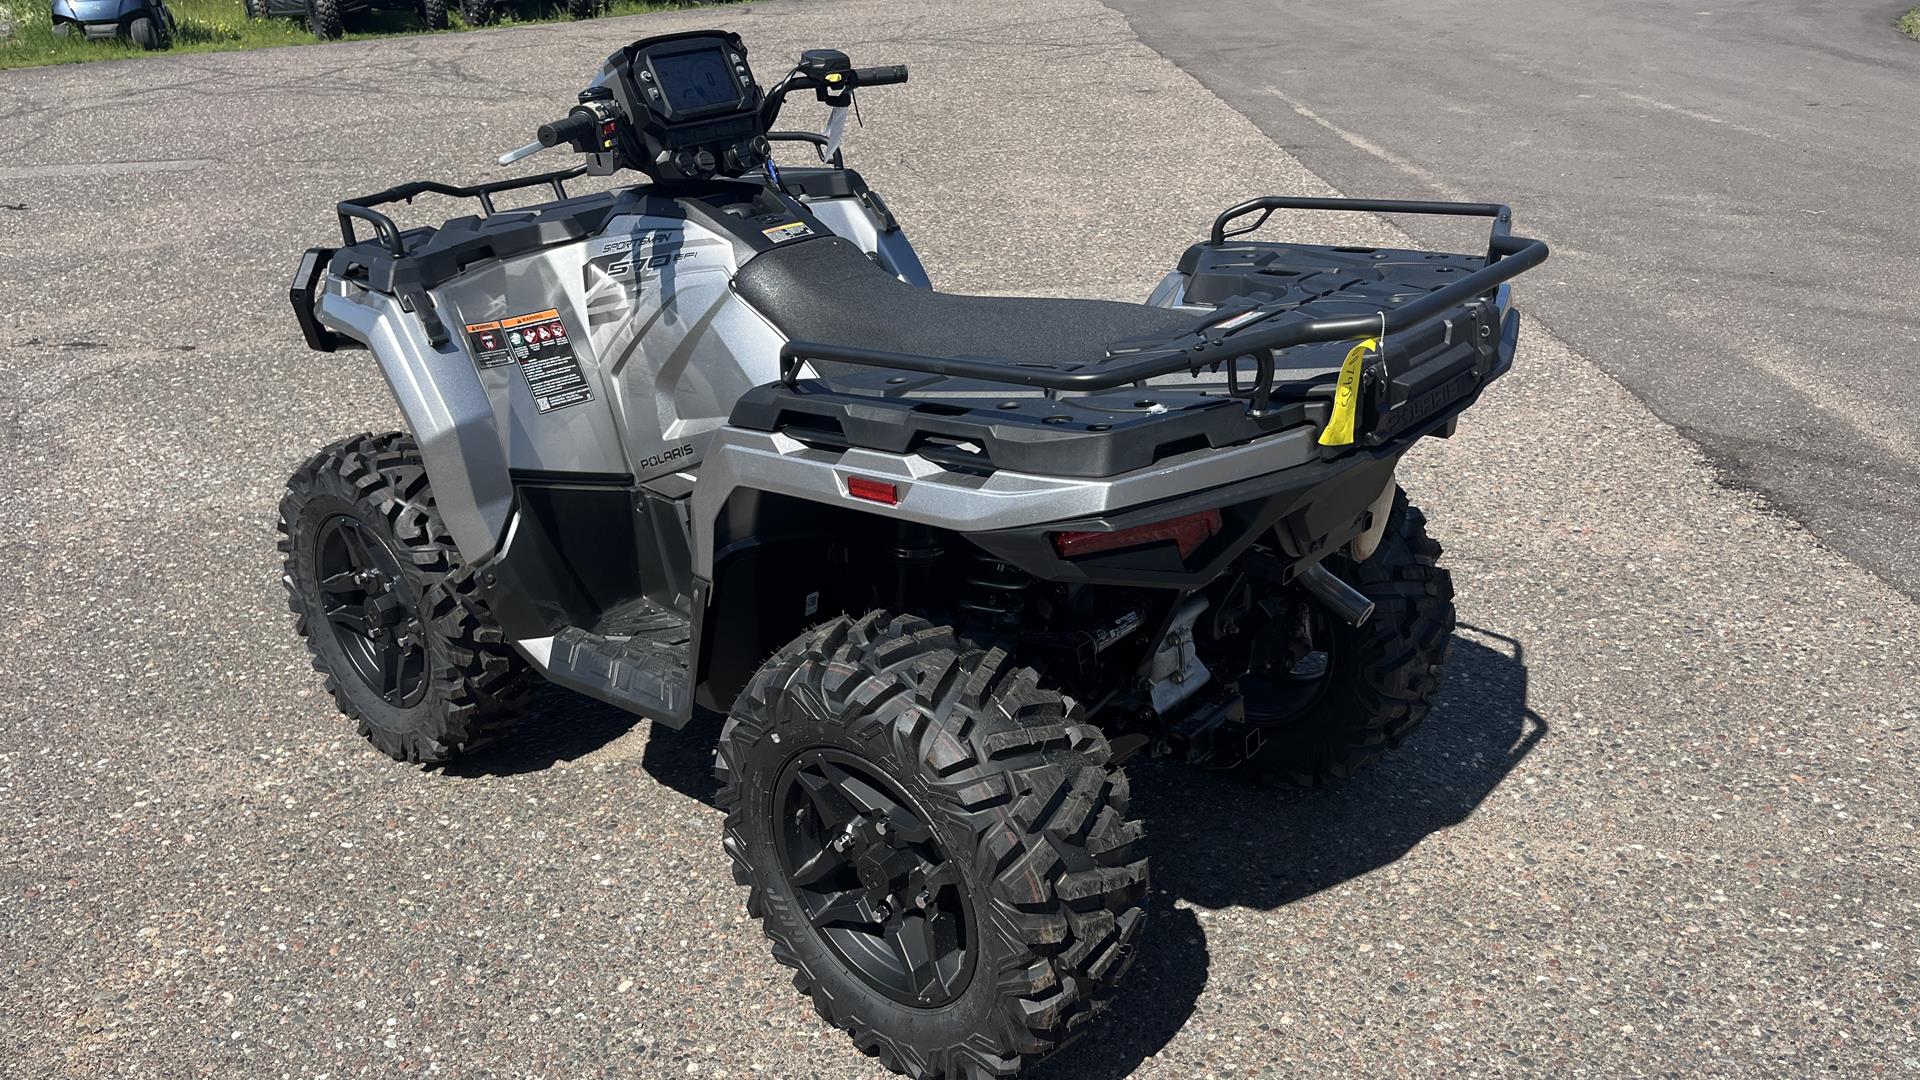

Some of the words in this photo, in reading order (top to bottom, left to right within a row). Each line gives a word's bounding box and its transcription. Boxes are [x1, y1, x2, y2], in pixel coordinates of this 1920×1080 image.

[603, 233, 672, 253] SPORTSMAN
[608, 254, 671, 276] 570
[674, 252, 697, 262] EFI
[640, 444, 693, 470] POLARIS
